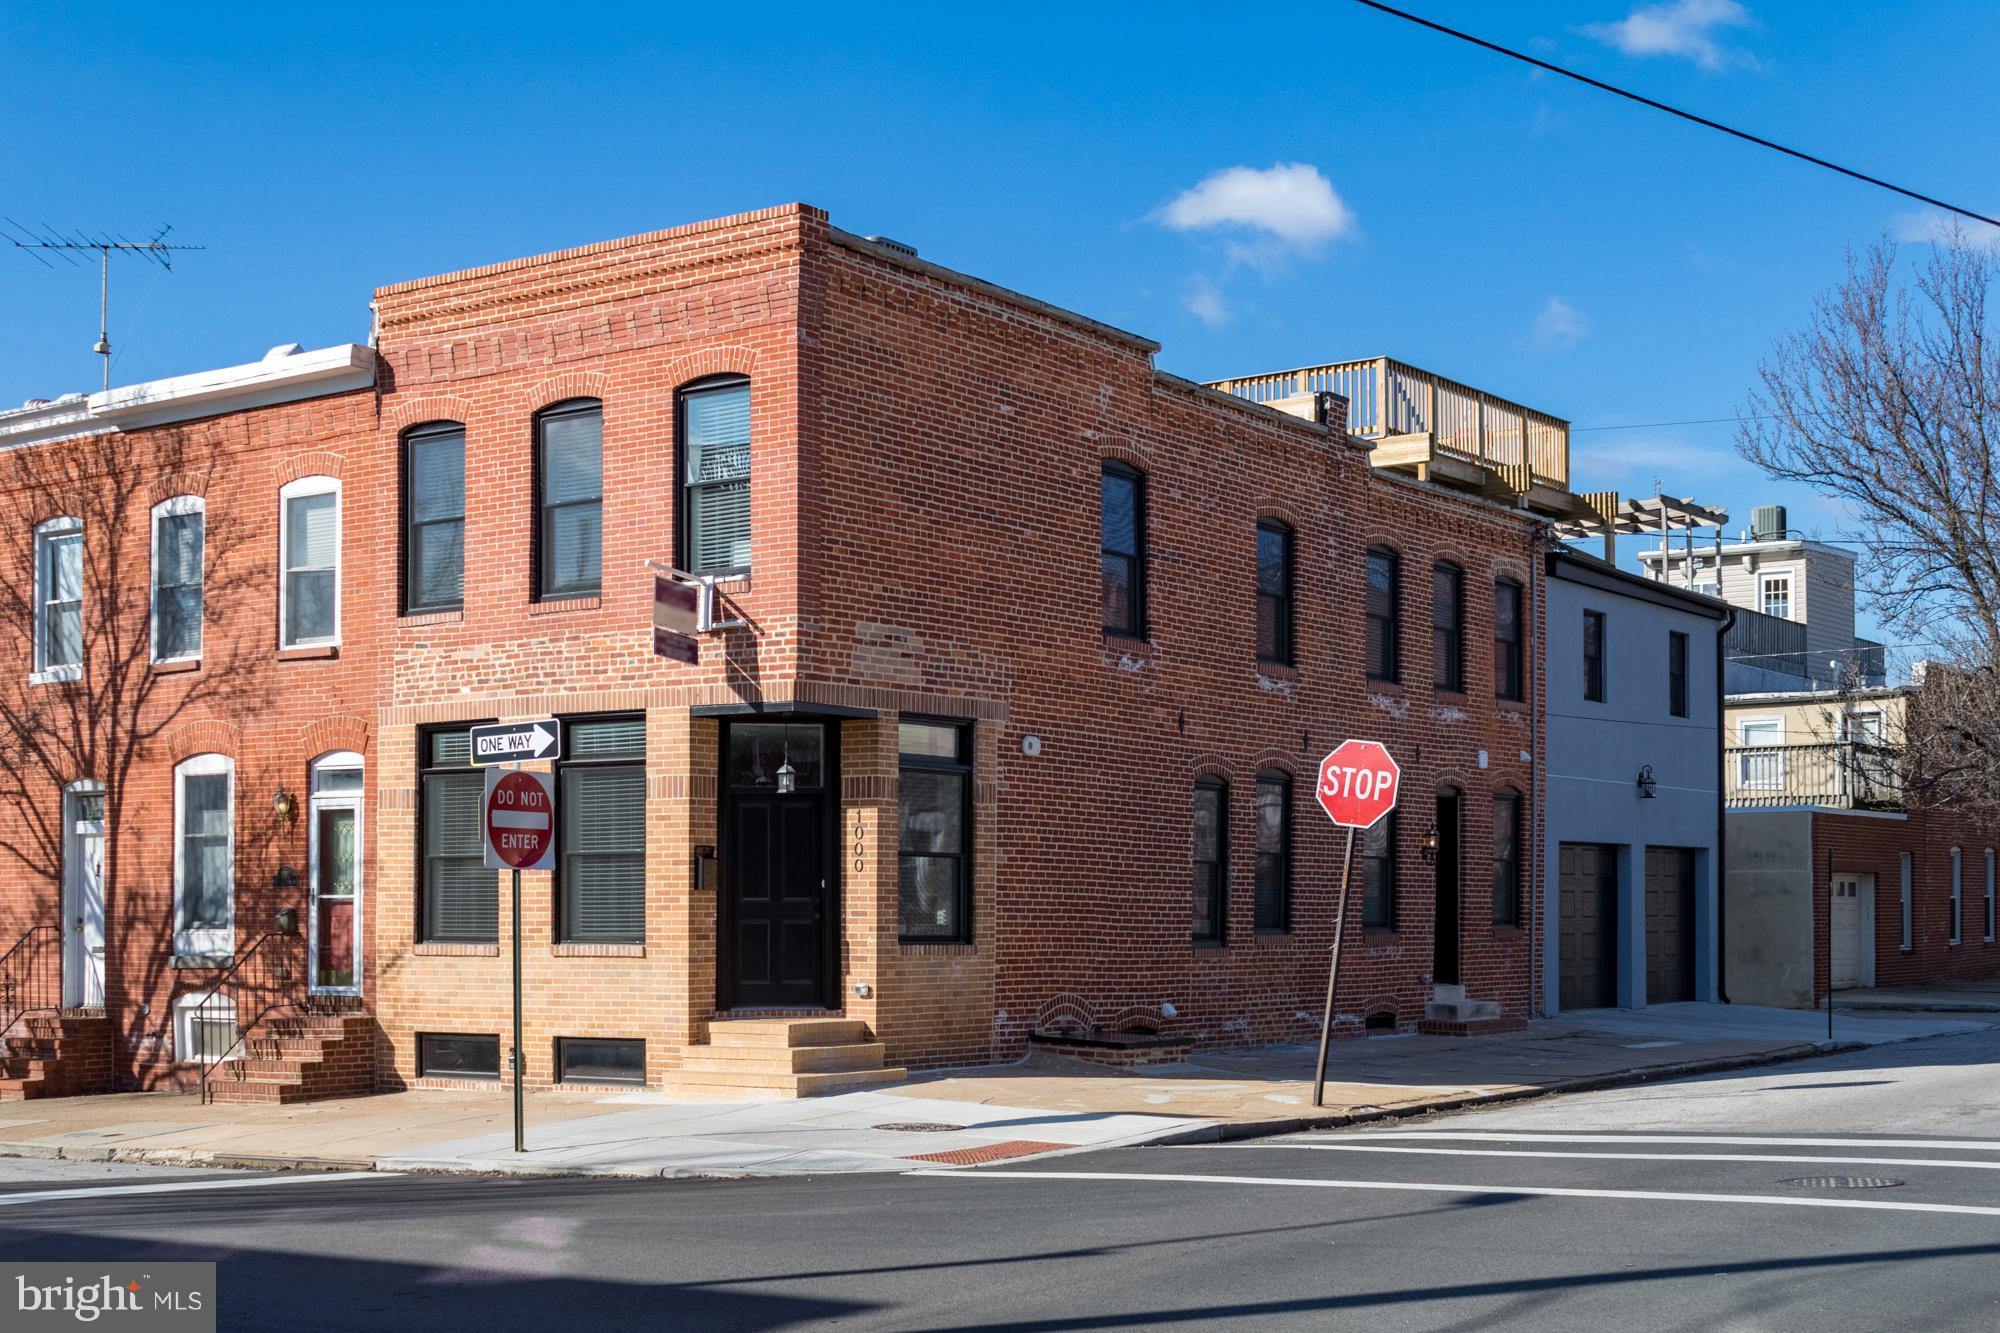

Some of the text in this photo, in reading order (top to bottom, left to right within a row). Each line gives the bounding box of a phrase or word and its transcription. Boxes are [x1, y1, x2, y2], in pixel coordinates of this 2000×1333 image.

[481, 734, 532, 753] ONE WAY
[1323, 765, 1392, 800] STOP
[498, 790, 544, 807] DO NOT
[501, 833, 539, 849] ENTER
[854, 809, 864, 873] 1000
